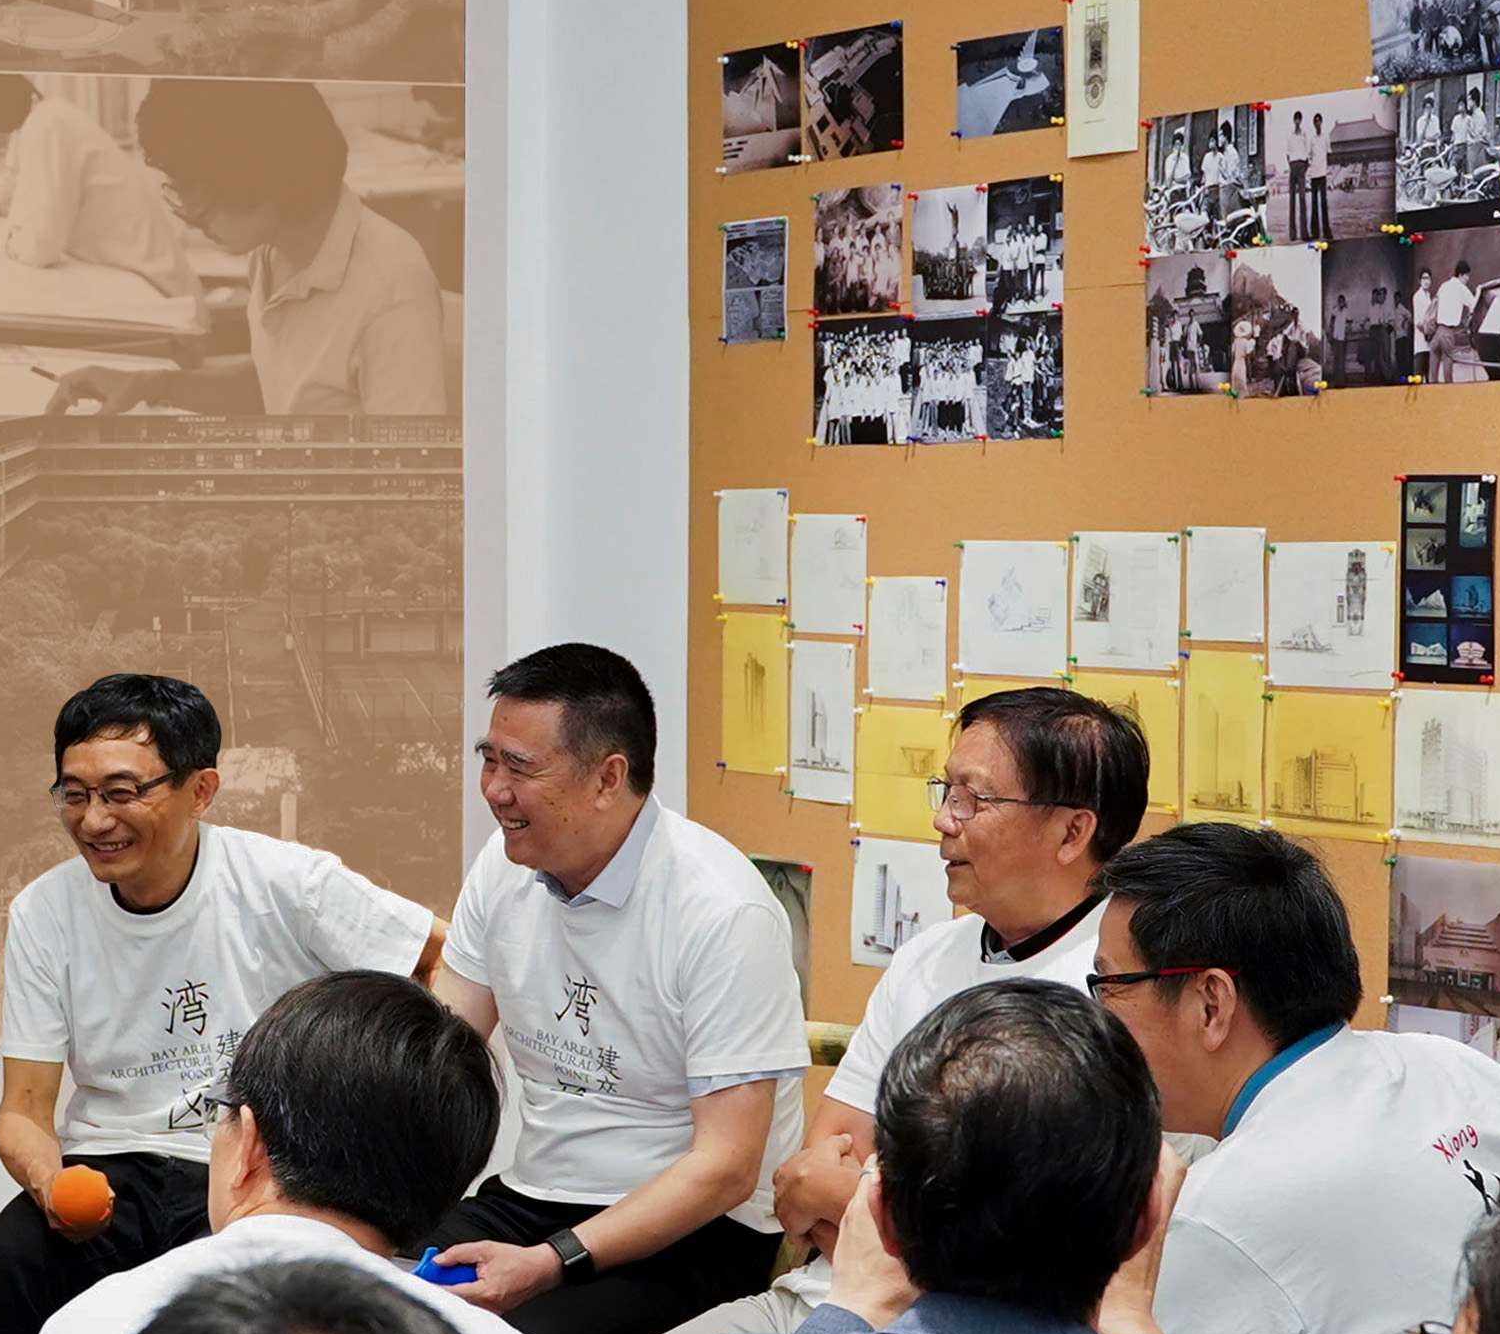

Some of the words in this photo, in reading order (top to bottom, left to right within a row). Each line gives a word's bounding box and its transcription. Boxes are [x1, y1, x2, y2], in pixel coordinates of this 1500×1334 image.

[160, 979, 210, 1036] 湾
[554, 973, 599, 1038] 湾
[150, 1046, 178, 1063] BAY
[536, 1029, 560, 1047] BAY
[560, 1039, 595, 1060] AREA
[109, 1055, 213, 1080] ARCHITECTURAL
[553, 1062, 593, 1084] POINT
[1432, 1123, 1479, 1164] Xiong
